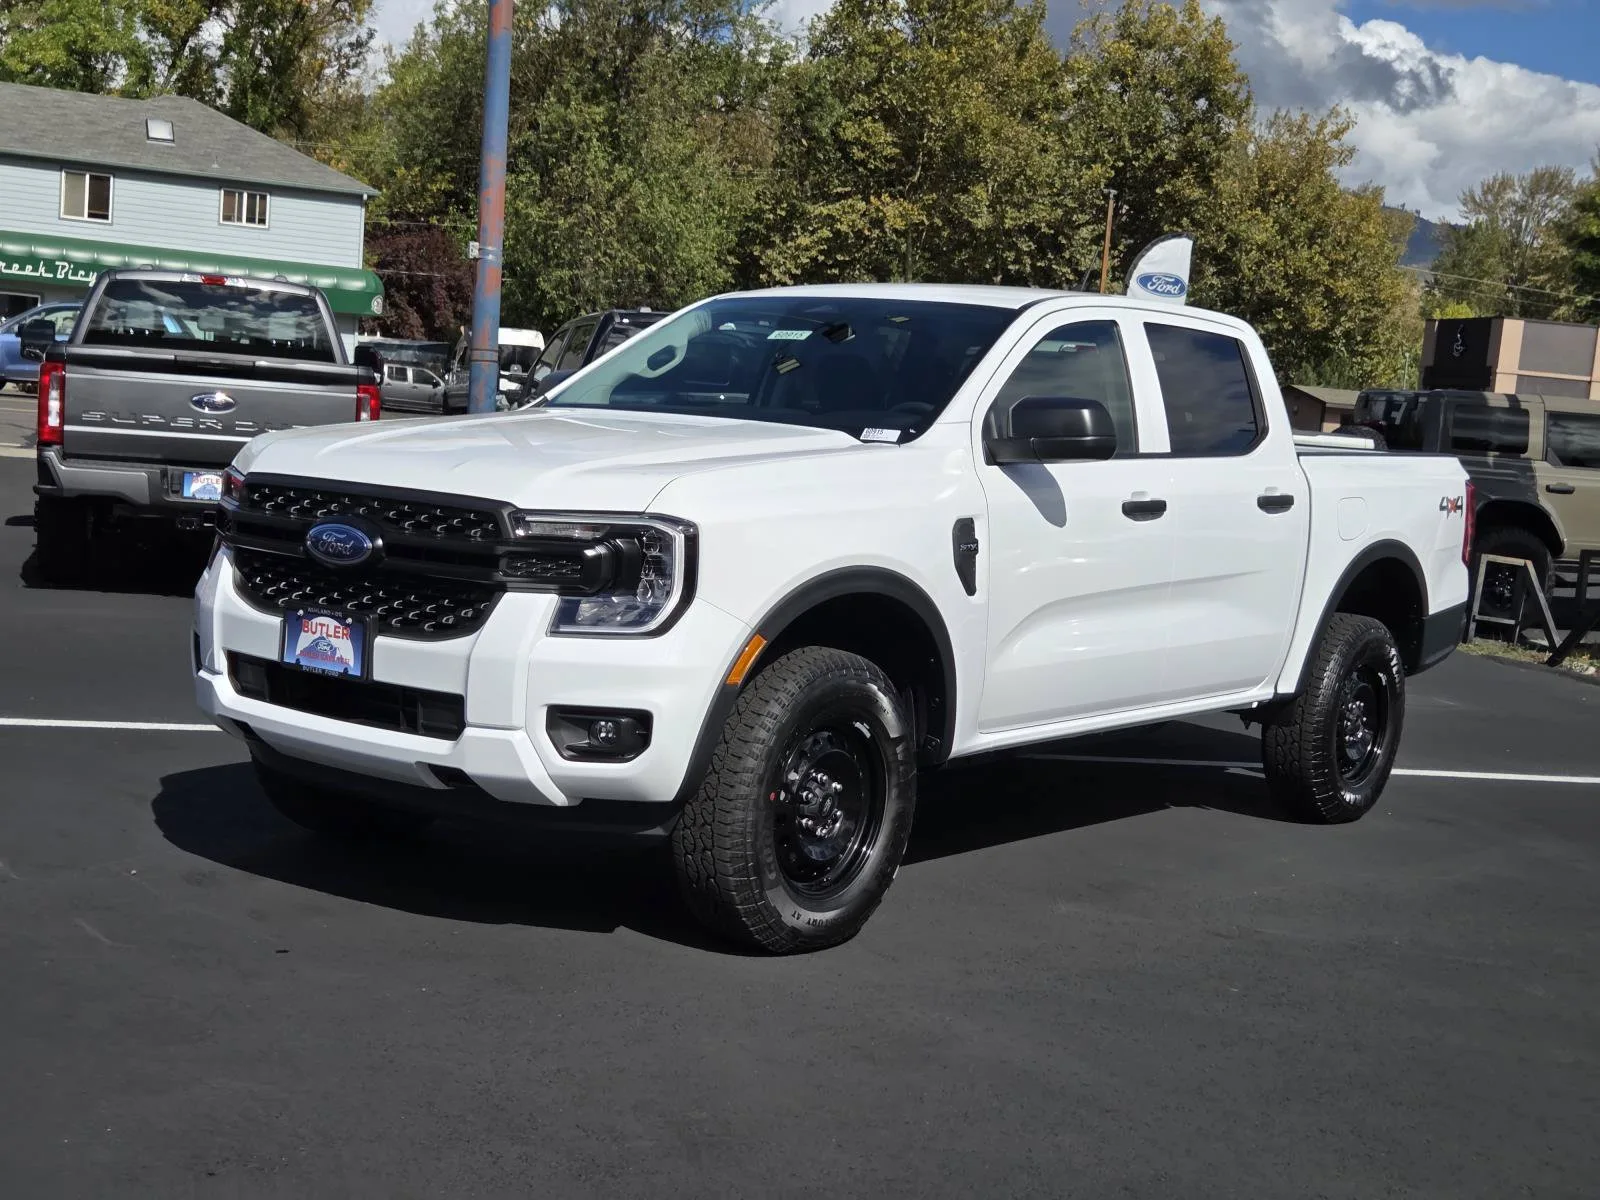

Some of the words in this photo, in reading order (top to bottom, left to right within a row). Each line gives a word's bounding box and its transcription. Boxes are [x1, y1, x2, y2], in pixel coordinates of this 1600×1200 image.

[1147, 275, 1181, 294] Ford
[82, 410, 222, 430] SUPER
[319, 531, 354, 555] Ford
[302, 618, 351, 640] BUTLER
